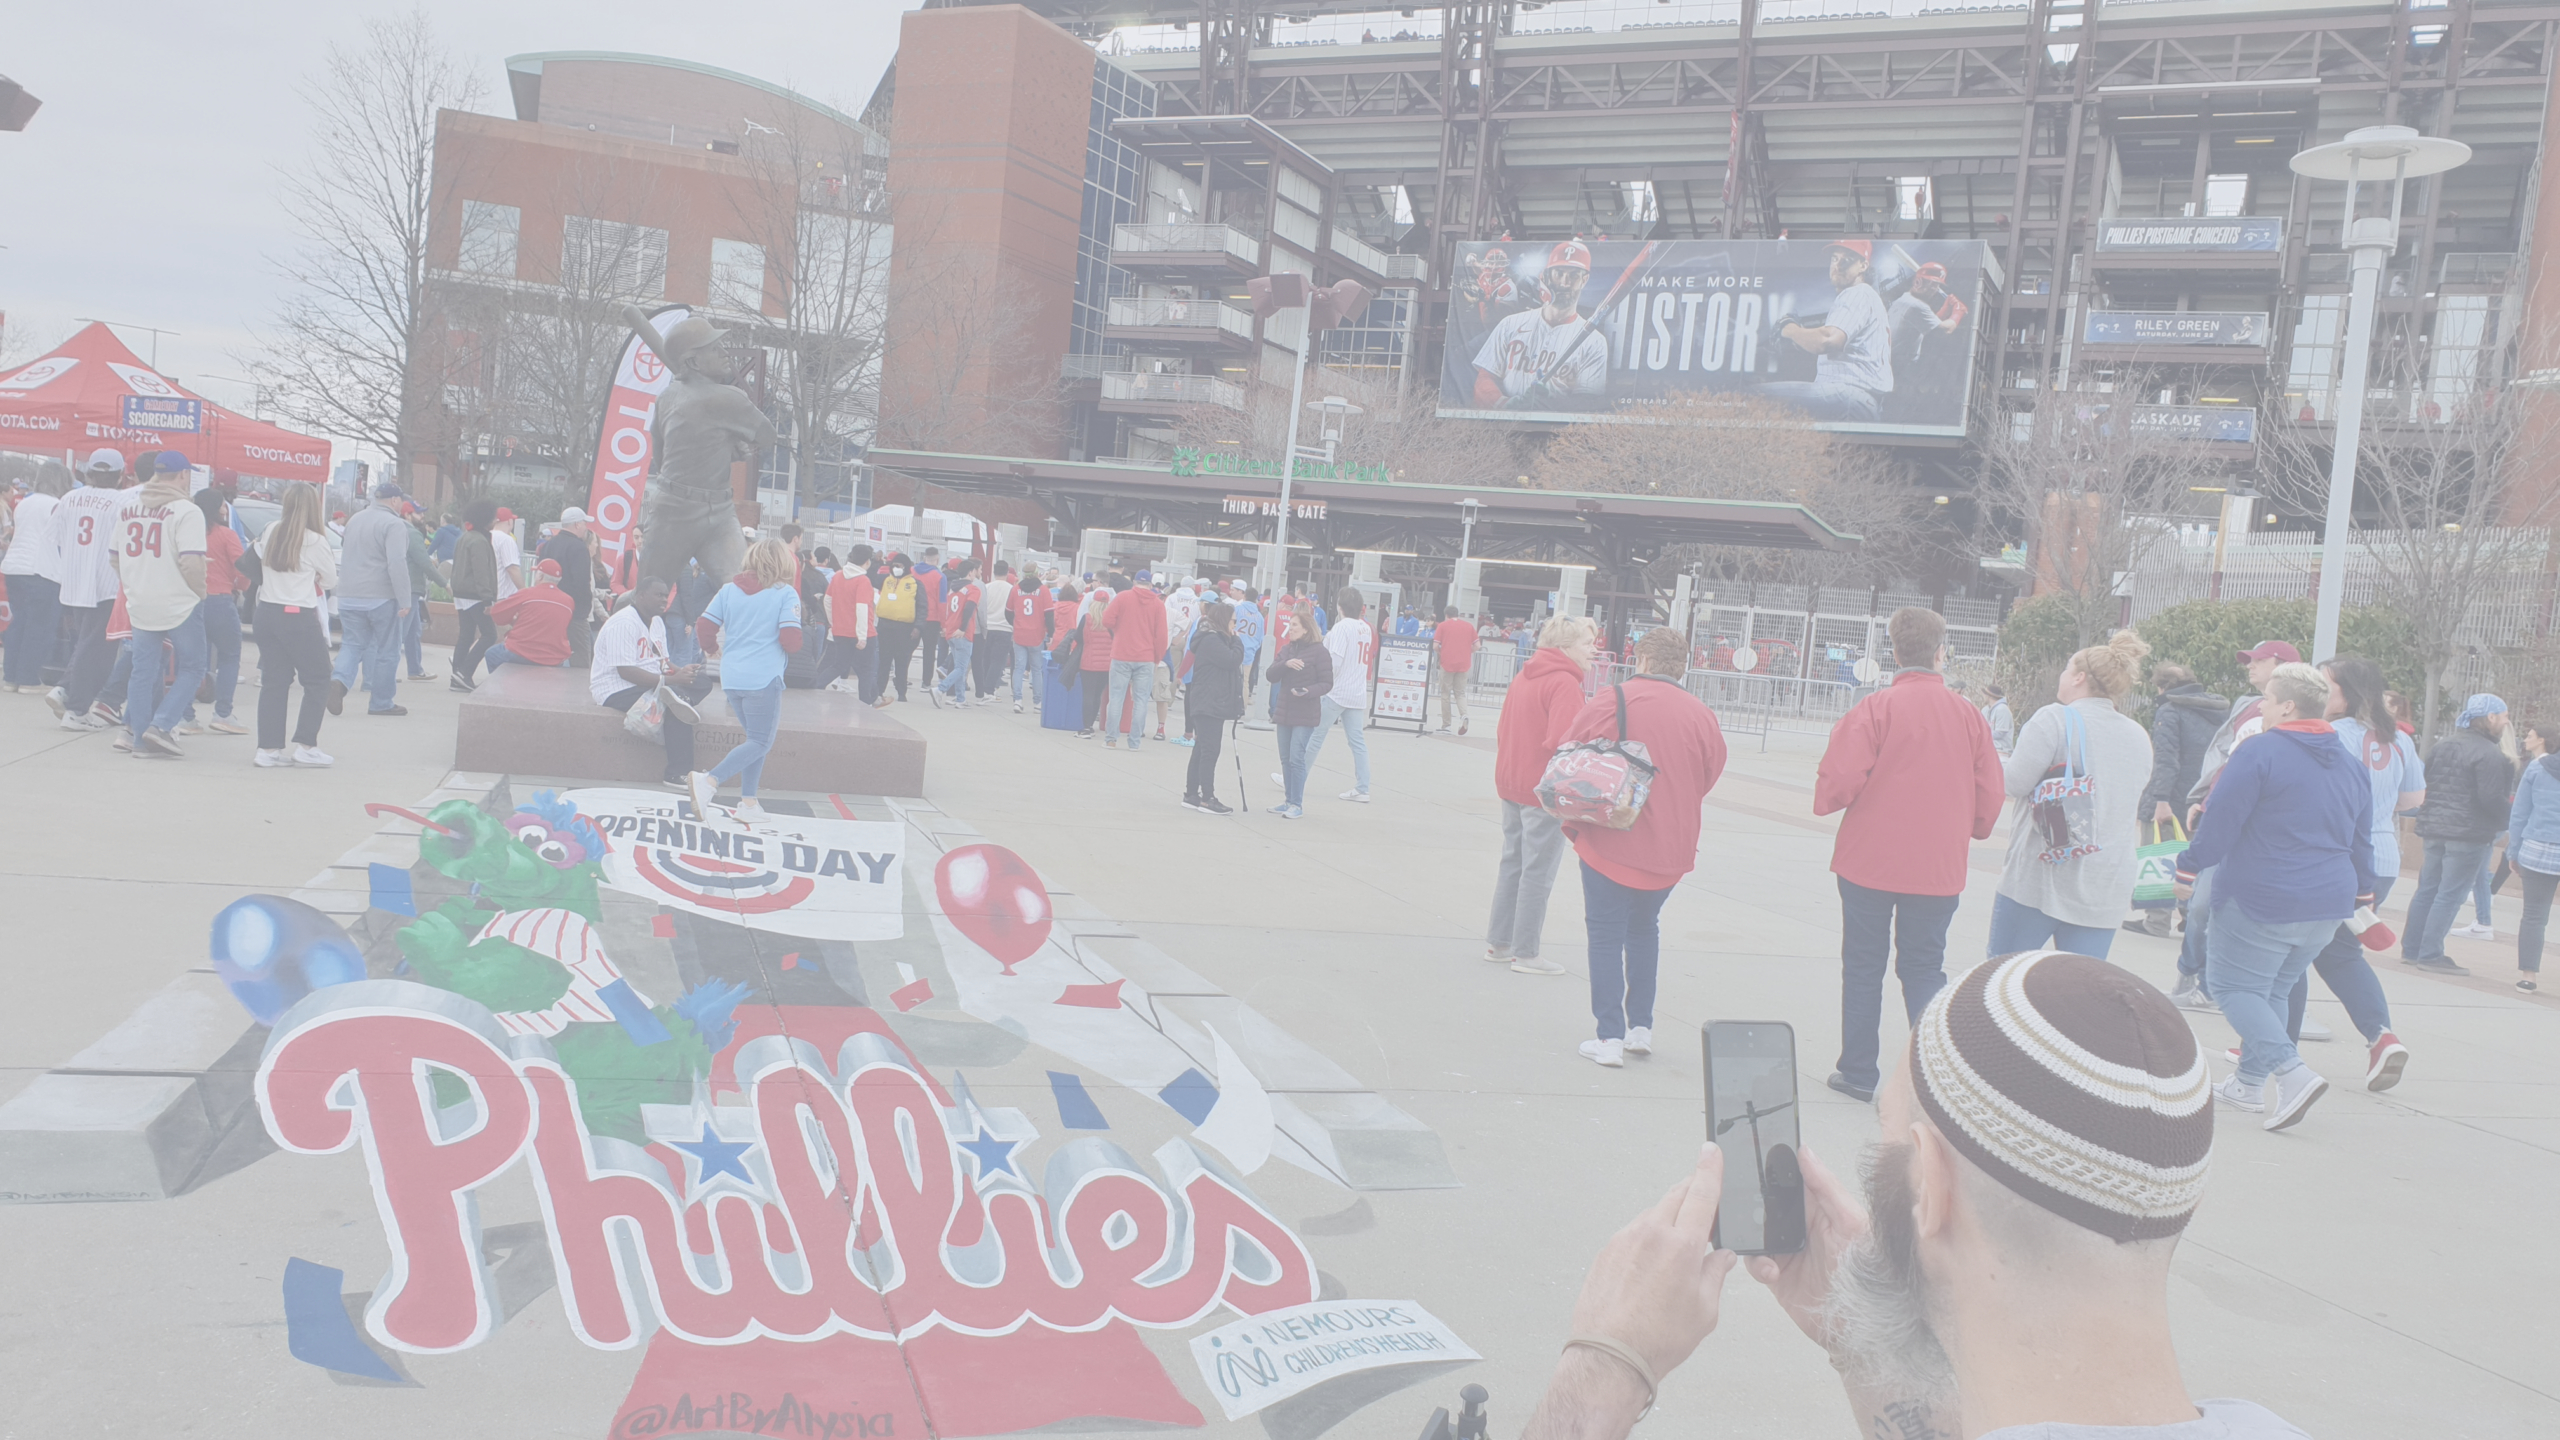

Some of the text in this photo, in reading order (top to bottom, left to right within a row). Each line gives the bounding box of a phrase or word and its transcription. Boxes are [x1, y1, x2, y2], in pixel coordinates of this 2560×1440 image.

[2104, 227, 2144, 245] PHILLIES
[2144, 227, 2193, 245] POSTGAME
[2193, 226, 2241, 244] CONCERTS
[1641, 276, 1764, 288] MAKE MORE
[2135, 319, 2219, 331] RILEY GREEN
[1506, 340, 1579, 382] Philles
[0, 414, 60, 430] OTA.COM
[128, 411, 195, 430] SCORECARDS
[244, 444, 322, 467] TOYOTA.COM
[1203, 453, 1391, 482] Citizens Bank Park
[597, 402, 656, 577] TOYOT
[68, 495, 113, 512] HARPER
[1222, 499, 1256, 515] THIRD
[1297, 504, 1327, 520] GATE
[77, 515, 94, 546] 3
[126, 522, 162, 558] 34
[1023, 598, 1034, 616] 3
[1237, 618, 1257, 637] 20
[1280, 621, 1290, 639] 7
[1407, 641, 1430, 649] POLICY
[694, 729, 747, 745] CHMID
[634, 806, 675, 818] 20
[759, 828, 809, 842] 24
[594, 814, 896, 885] OPENING DAY
[255, 994, 1319, 1353] Phillies
[1261, 1307, 1416, 1345] NEMOURS
[1377, 1330, 1446, 1354] HEALTH
[612, 1391, 895, 1440] @ArtByAlysia
